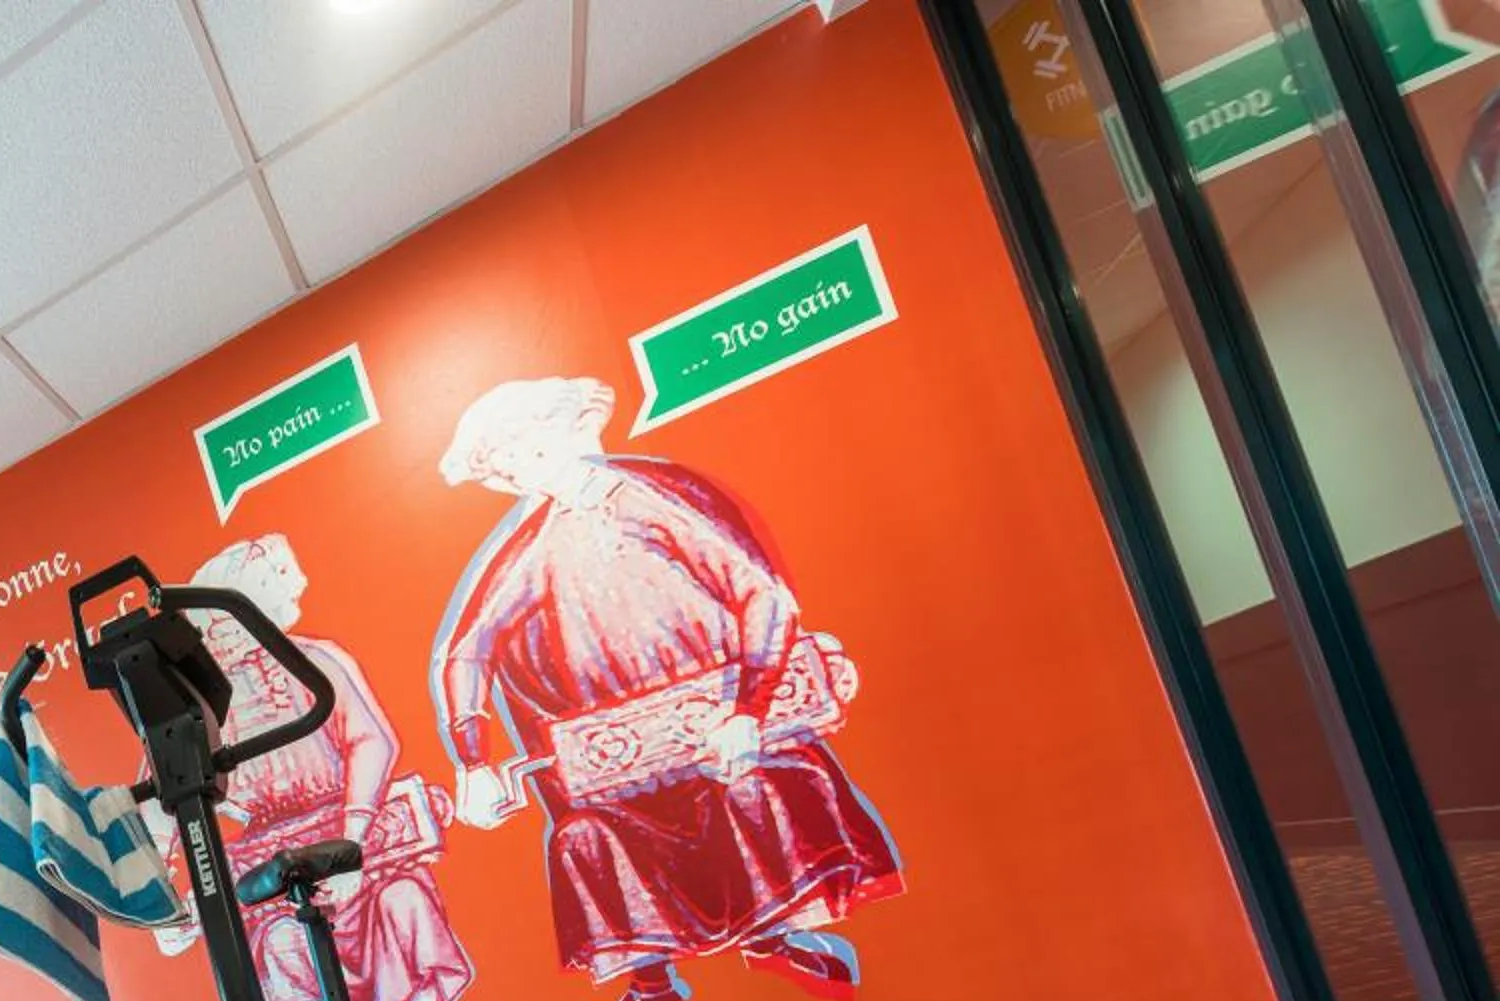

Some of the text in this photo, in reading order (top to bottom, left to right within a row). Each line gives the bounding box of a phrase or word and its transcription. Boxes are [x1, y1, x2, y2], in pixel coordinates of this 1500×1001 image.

[712, 320, 768, 358] No
[777, 280, 852, 336] gain
[222, 437, 262, 467] No
[267, 406, 321, 448] pain
[187, 820, 217, 896] KETTLER
